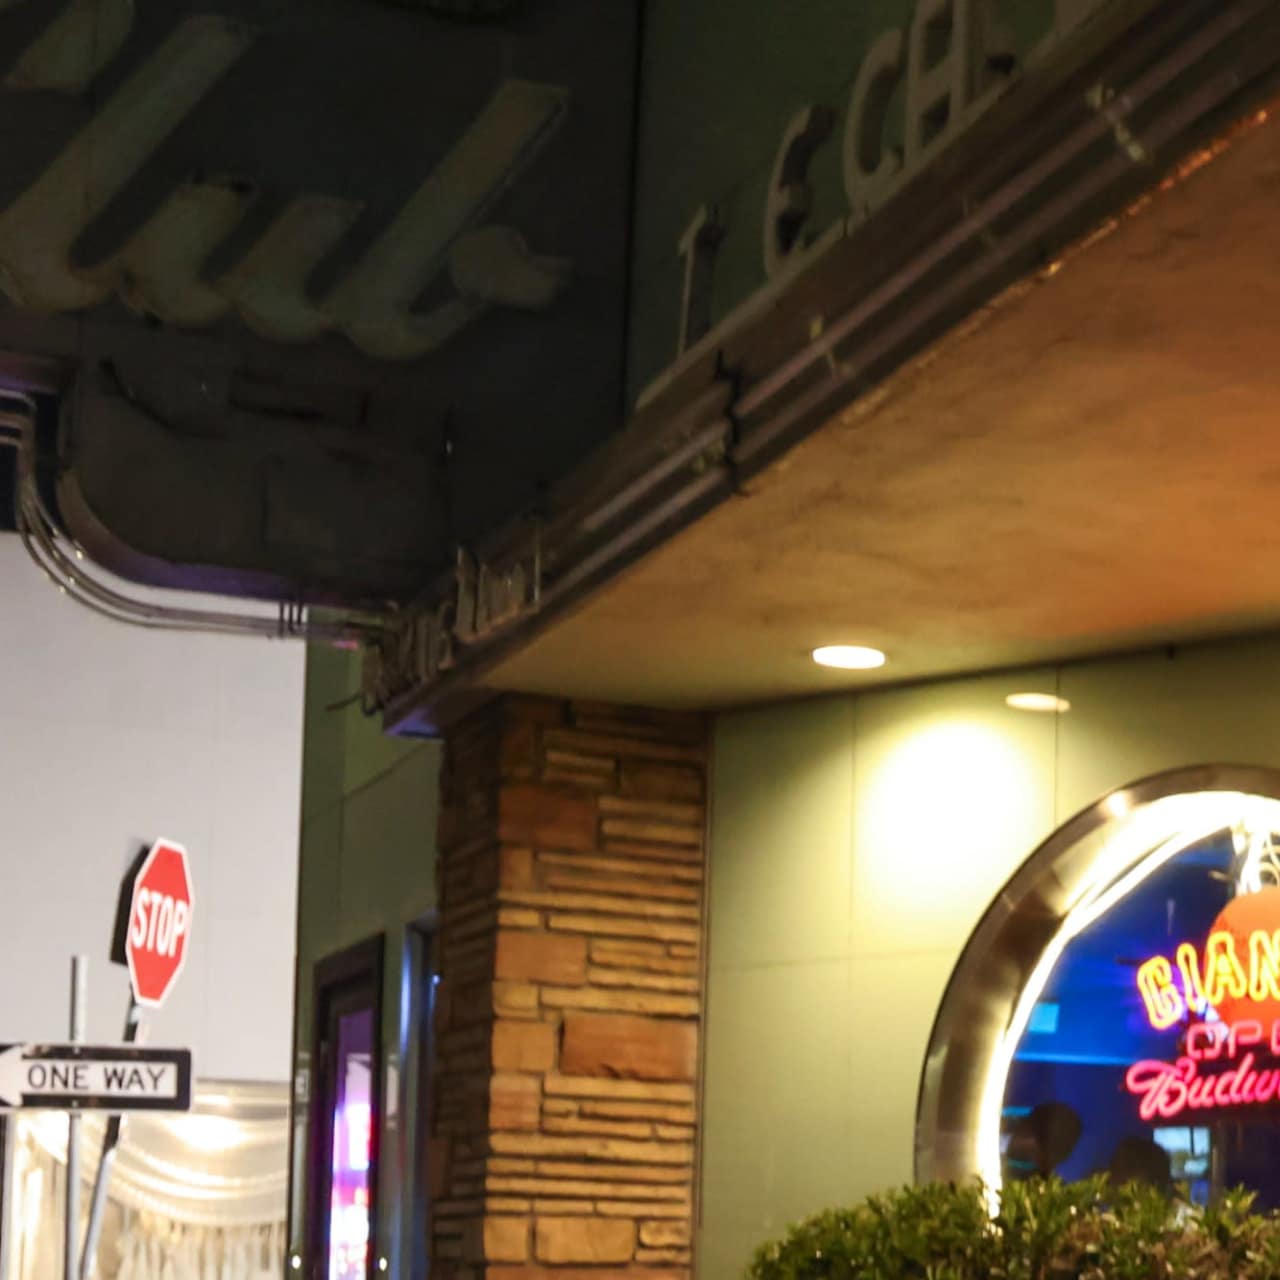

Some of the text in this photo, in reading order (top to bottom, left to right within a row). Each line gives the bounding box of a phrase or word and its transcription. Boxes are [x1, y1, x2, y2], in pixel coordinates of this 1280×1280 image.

[0, 0, 573, 360] lub
[132, 887, 187, 957] STOP
[28, 1064, 166, 1091] ONE WAY
